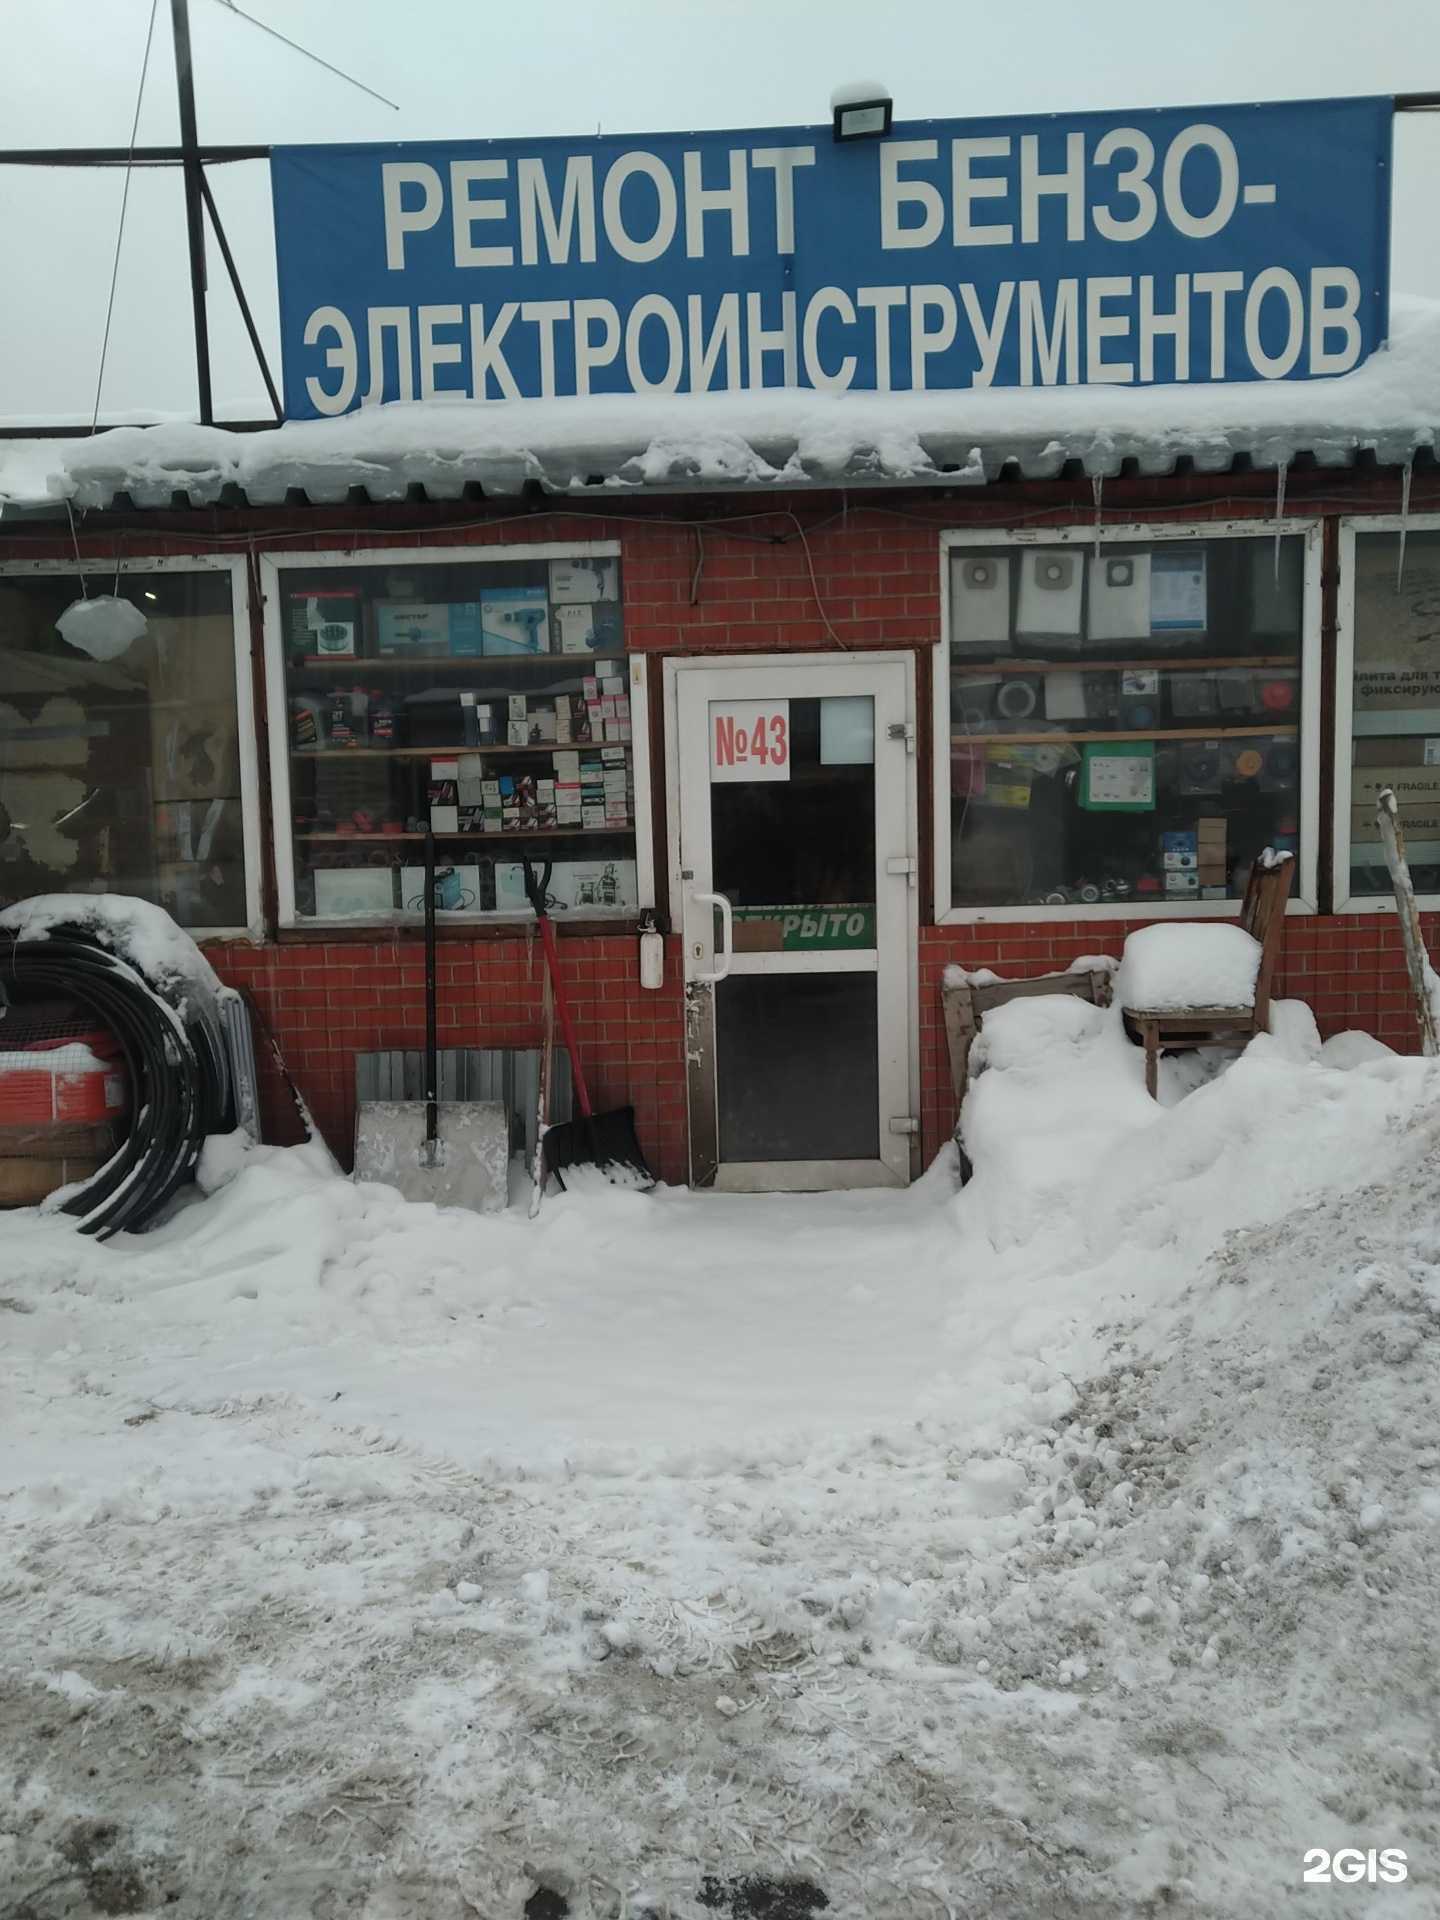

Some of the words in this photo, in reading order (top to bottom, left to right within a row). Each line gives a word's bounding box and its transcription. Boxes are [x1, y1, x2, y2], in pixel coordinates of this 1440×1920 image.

[381, 145, 817, 271] РЕМОНТ
[879, 123, 1277, 250] БЕНЗО-
[303, 266, 1362, 416] ЭЛЕКТРОИНСТРУМЕНТОВ
[716, 715, 787, 766] №43
[1397, 782, 1440, 791] FRAGILE
[731, 913, 865, 938] РЫТО
